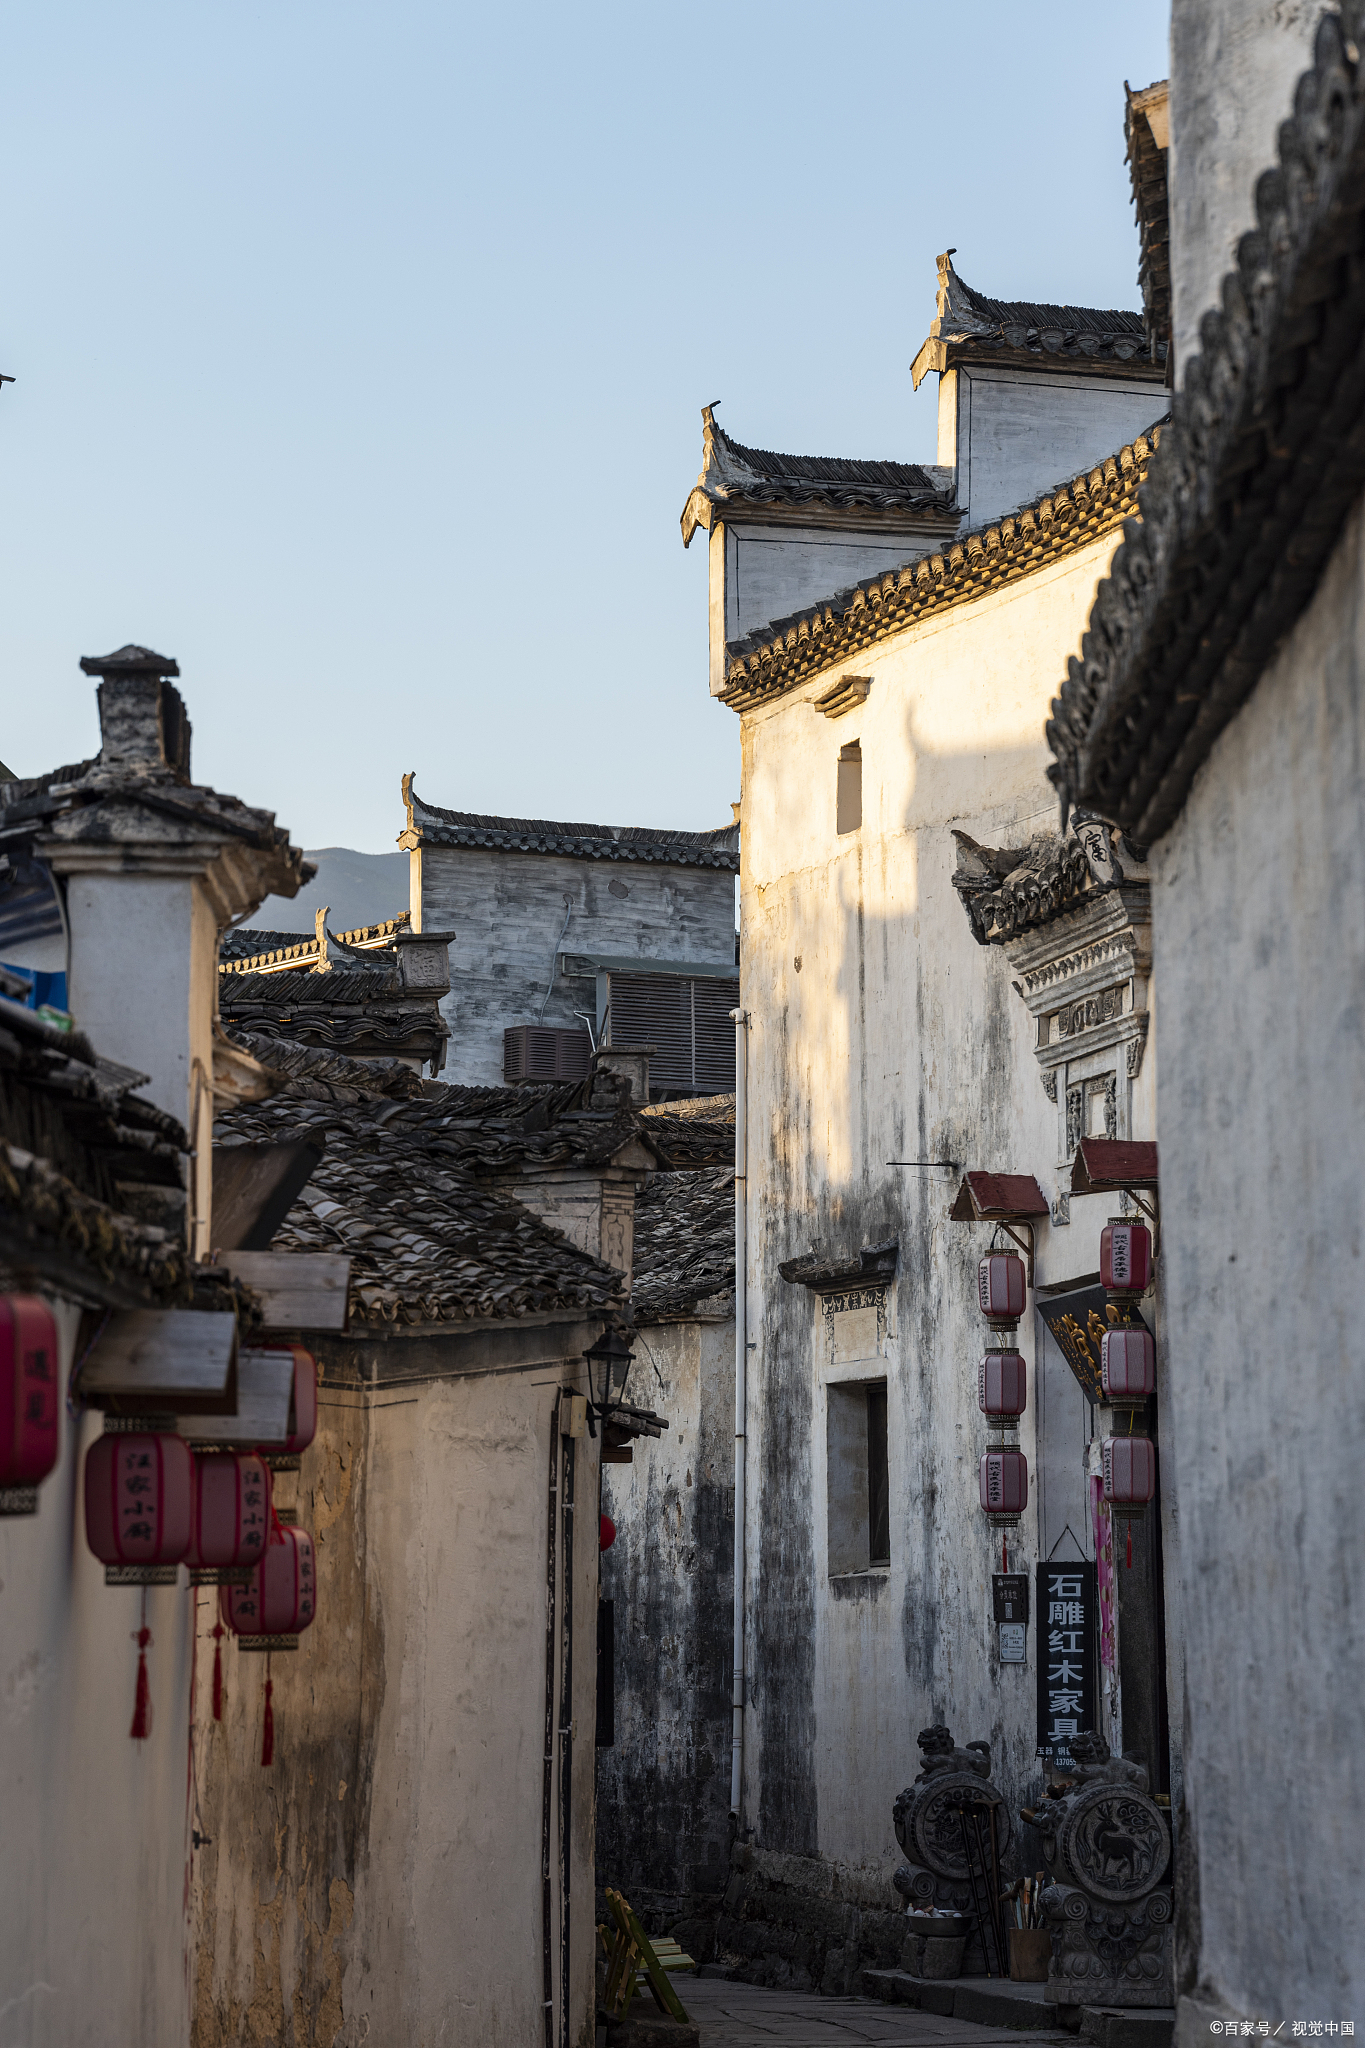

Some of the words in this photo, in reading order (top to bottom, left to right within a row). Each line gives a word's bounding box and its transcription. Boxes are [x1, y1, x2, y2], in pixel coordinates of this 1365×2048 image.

[1047, 1574, 1085, 1742] 石雕红木家具
[1037, 1746, 1053, 1755] 玉器
